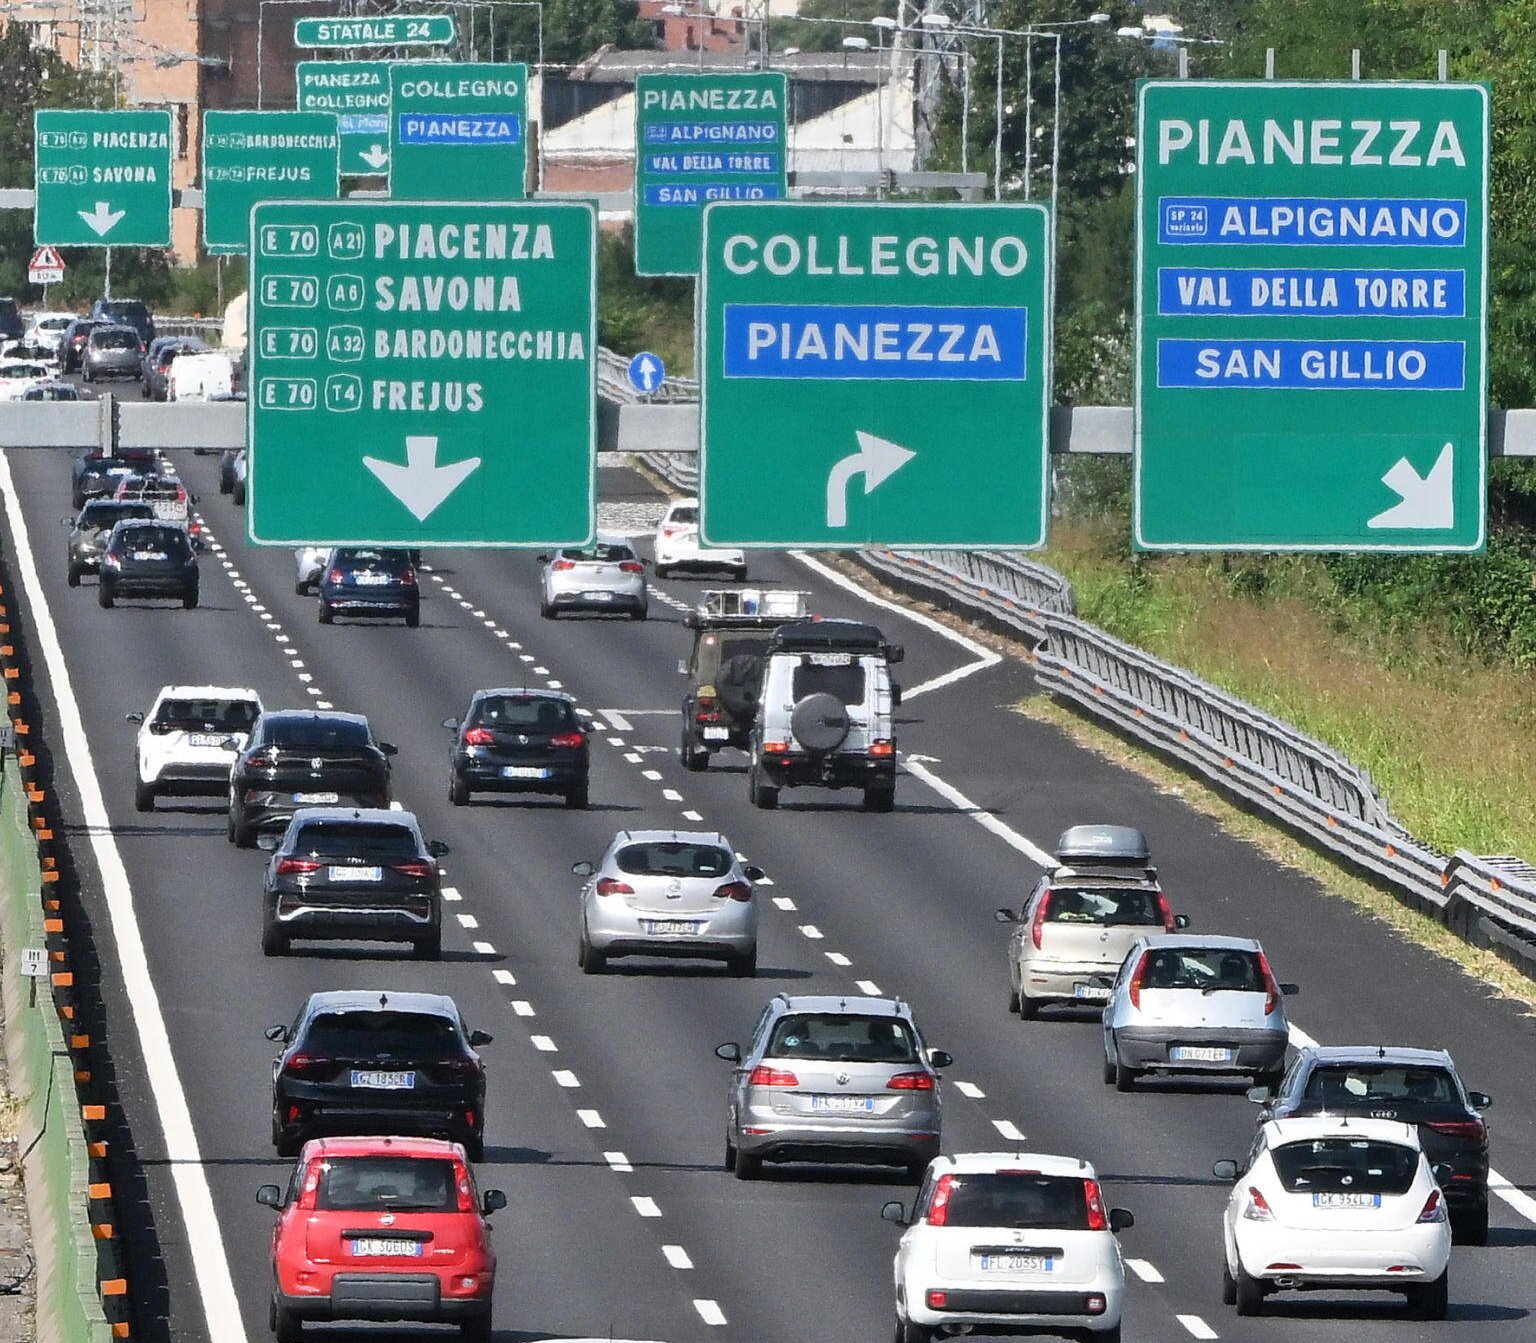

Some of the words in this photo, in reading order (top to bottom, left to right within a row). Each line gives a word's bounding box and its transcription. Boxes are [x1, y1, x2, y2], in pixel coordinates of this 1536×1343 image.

[318, 23, 395, 39] STATALE
[407, 22, 430, 37] 24
[305, 73, 380, 87] PIANEZZA
[401, 80, 518, 97] COLLEGNO
[305, 94, 389, 108] COLLEGNO
[644, 90, 777, 110] PIANEZZA
[407, 121, 511, 137] PIANEZZA
[671, 125, 776, 139] ALPIGNANO
[93, 132, 167, 148] PIACENZA
[247, 134, 336, 148] BARDONECCHIA
[1159, 120, 1466, 166] PIANEZZA
[652, 156, 678, 170] VAL
[683, 156, 722, 169] DELLA
[729, 156, 770, 170] TORRE
[93, 166, 156, 182] SAVONA
[247, 166, 310, 181] FREJUS
[659, 188, 697, 202] SAN
[706, 187, 764, 199] GILLIO
[1171, 211, 1184, 220] SP
[1190, 211, 1203, 220] 24
[1221, 207, 1460, 237] ALPIGNANO
[267, 231, 277, 250] E
[290, 231, 314, 251] 70
[375, 224, 554, 259] PIACENZA
[723, 234, 1029, 277] COLLEGNO
[267, 281, 277, 300] E
[290, 281, 314, 301] 70
[376, 276, 520, 312] SAVONA
[1178, 277, 1231, 306] VAL
[1252, 278, 1338, 307] DELLA
[1355, 278, 1447, 308] TORRE
[267, 333, 276, 352] E
[289, 333, 313, 352] 70
[375, 330, 584, 360] BARDONECCHIA
[749, 322, 1002, 361] PIANEZZA
[1196, 348, 1279, 380] SAN
[1301, 349, 1427, 380] GILLIO
[266, 384, 276, 404] E
[288, 384, 313, 404] 70
[373, 380, 484, 411] FREJUS
[30, 963, 37, 973] 7
